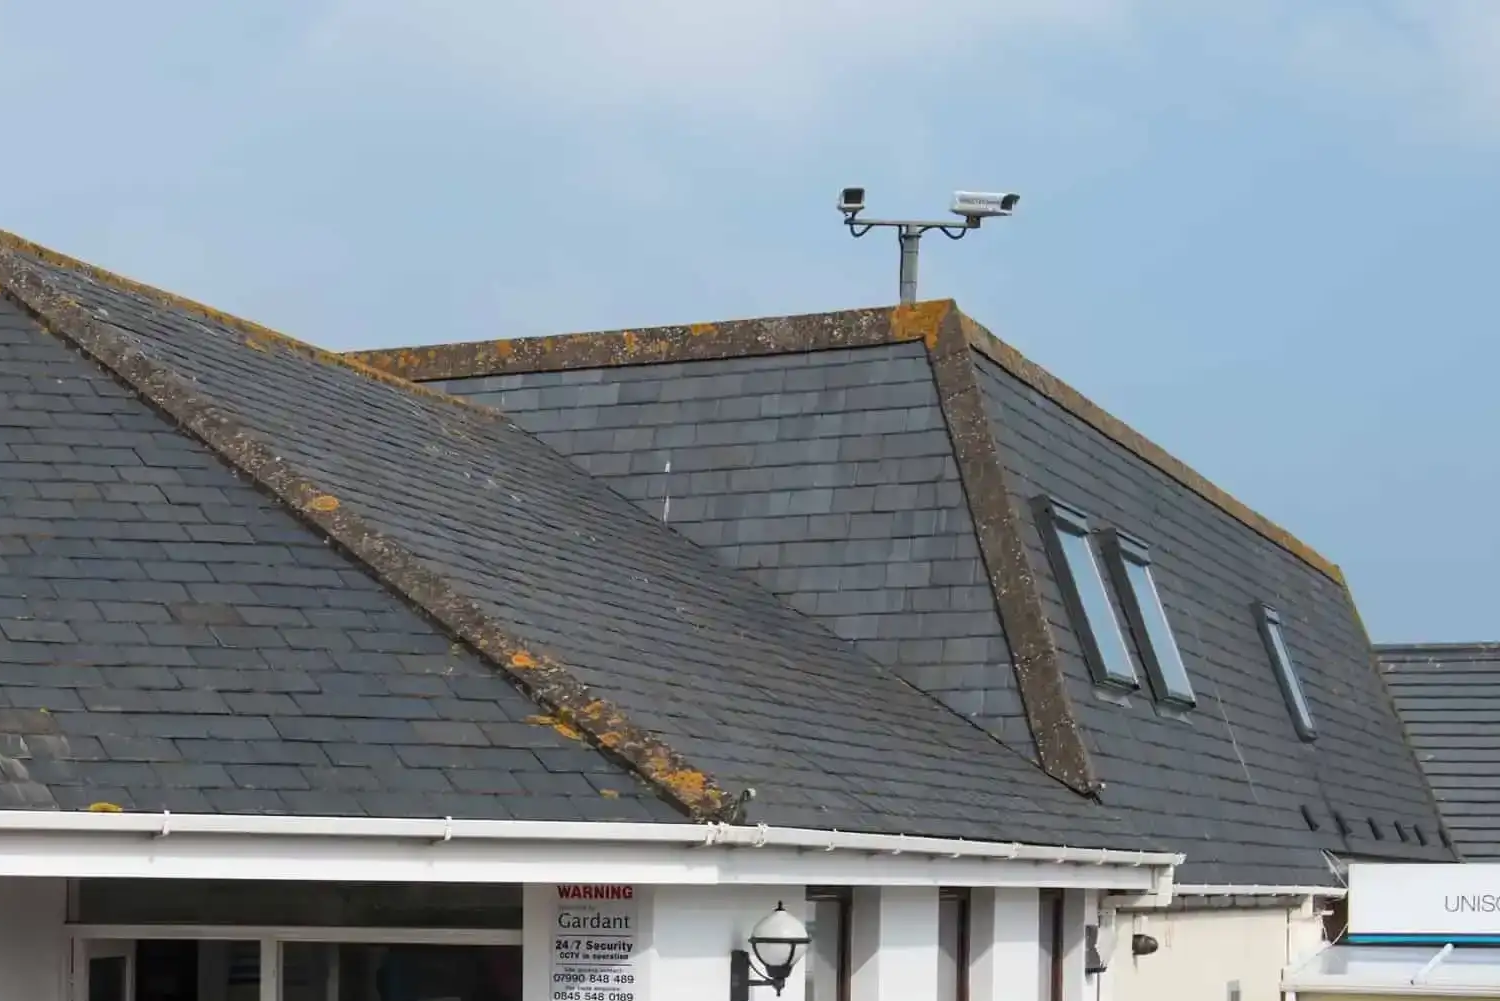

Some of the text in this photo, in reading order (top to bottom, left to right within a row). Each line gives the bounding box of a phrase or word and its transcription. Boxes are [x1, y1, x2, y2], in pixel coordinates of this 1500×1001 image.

[557, 885, 633, 899] WARNING
[558, 912, 631, 929] Gardant
[586, 940, 633, 952] Security
[589, 974, 610, 984] 848
[554, 992, 580, 1001] 0845
[585, 992, 605, 1001] 548
